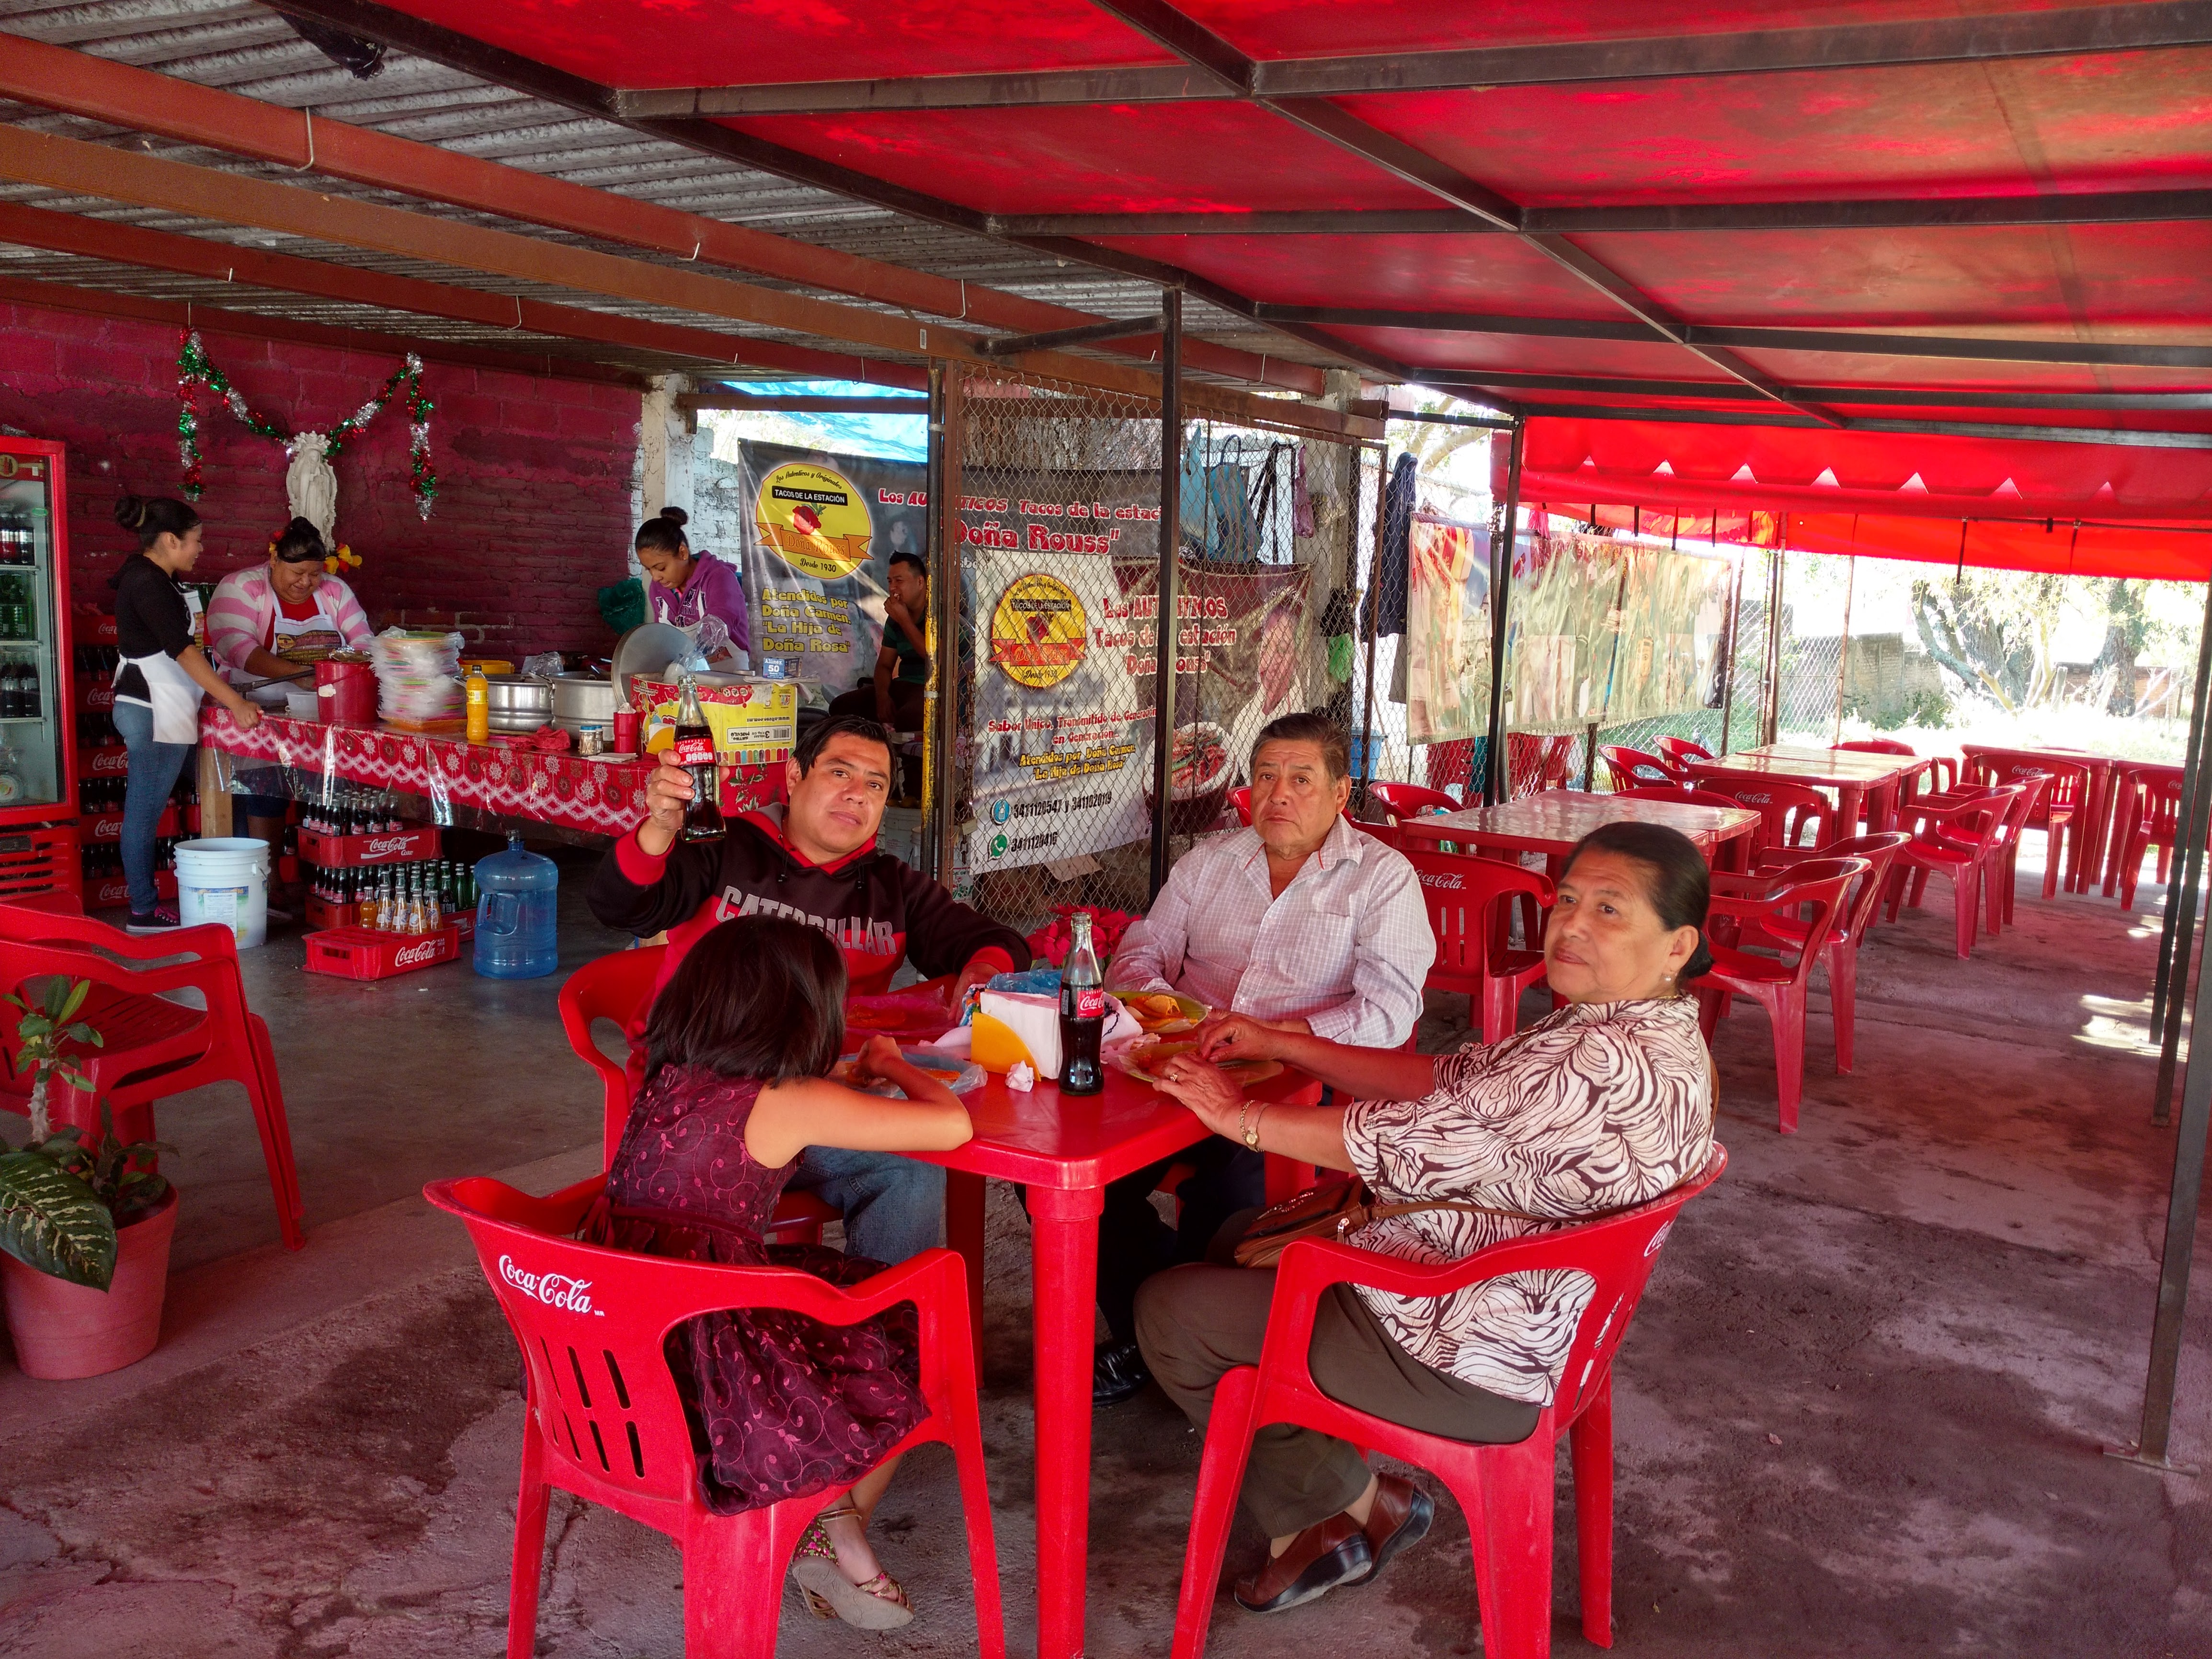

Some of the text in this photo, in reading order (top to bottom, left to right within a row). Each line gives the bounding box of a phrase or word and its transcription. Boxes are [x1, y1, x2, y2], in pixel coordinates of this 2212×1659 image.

[776, 475, 784, 483] Los
[816, 472, 842, 489] Originales
[775, 489, 795, 498] TACOS
[814, 493, 845, 503] ESTACIÓN
[878, 488, 903, 505] Los
[1019, 499, 1063, 517] Tacos
[1069, 501, 1089, 518] de
[1093, 502, 1111, 519] la
[786, 534, 845, 556] Doña Rouss
[800, 558, 836, 572] Desde 1930
[762, 588, 848, 609] Atendidos por
[762, 604, 851, 625] Doña Carmen,
[1103, 598, 1129, 619] Los
[763, 620, 842, 636] "La Hija de
[1092, 628, 1135, 648] Tacos
[1138, 624, 1154, 648] de
[763, 637, 851, 653] Doña Rosa"
[988, 719, 1021, 732] Sabor
[1110, 711, 1121, 722] de
[679, 742, 704, 753] Coca-Cola
[1052, 735, 1065, 744] en
[1019, 751, 1063, 767] Atendidos
[1065, 751, 1081, 764] por
[1069, 763, 1081, 775] de
[1735, 791, 1771, 804] Coca-Cola
[369, 837, 408, 852] Coca-Cola
[395, 939, 437, 967] Coca-Cola
[499, 1255, 593, 1313] Coca-Cola
